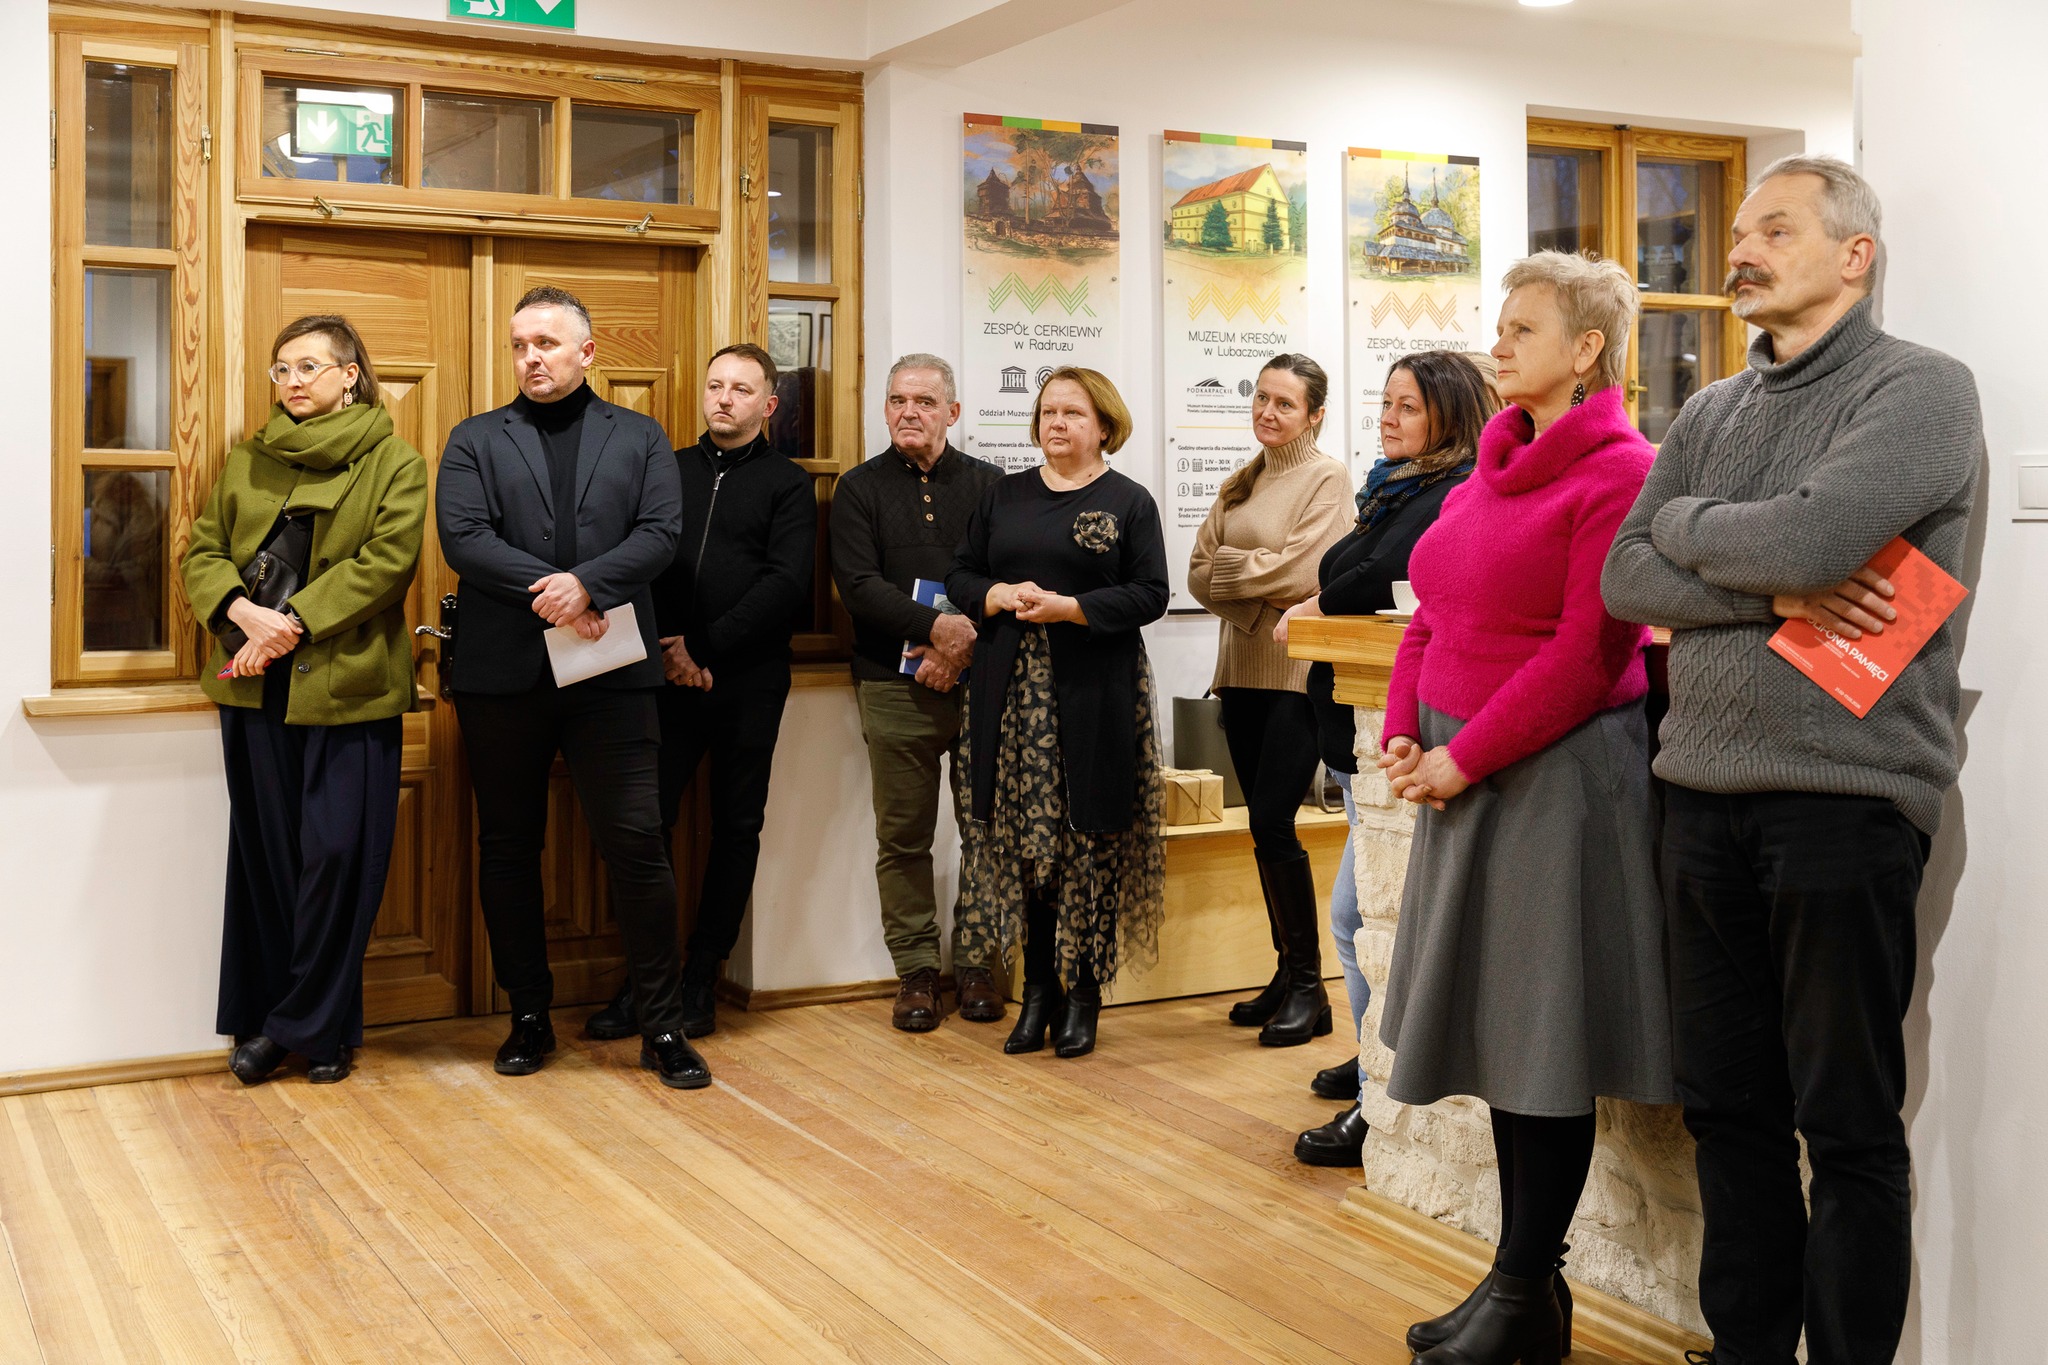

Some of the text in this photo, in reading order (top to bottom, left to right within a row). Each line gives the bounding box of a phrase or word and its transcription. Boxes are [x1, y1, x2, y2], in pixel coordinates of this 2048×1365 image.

[983, 321, 1103, 338] ZESPÓŁ CERKIEWNY
[1188, 331, 1287, 345] MUZEUM KRESÓW
[1367, 337, 1470, 351] ZESPÓŁ CERKIEWNY
[1014, 341, 1024, 350] w
[1204, 346, 1275, 358] w Lubaczowie
[1376, 354, 1385, 362] w
[978, 409, 1006, 417] Oddział
[1848, 647, 1889, 682] PAMIĘCI
